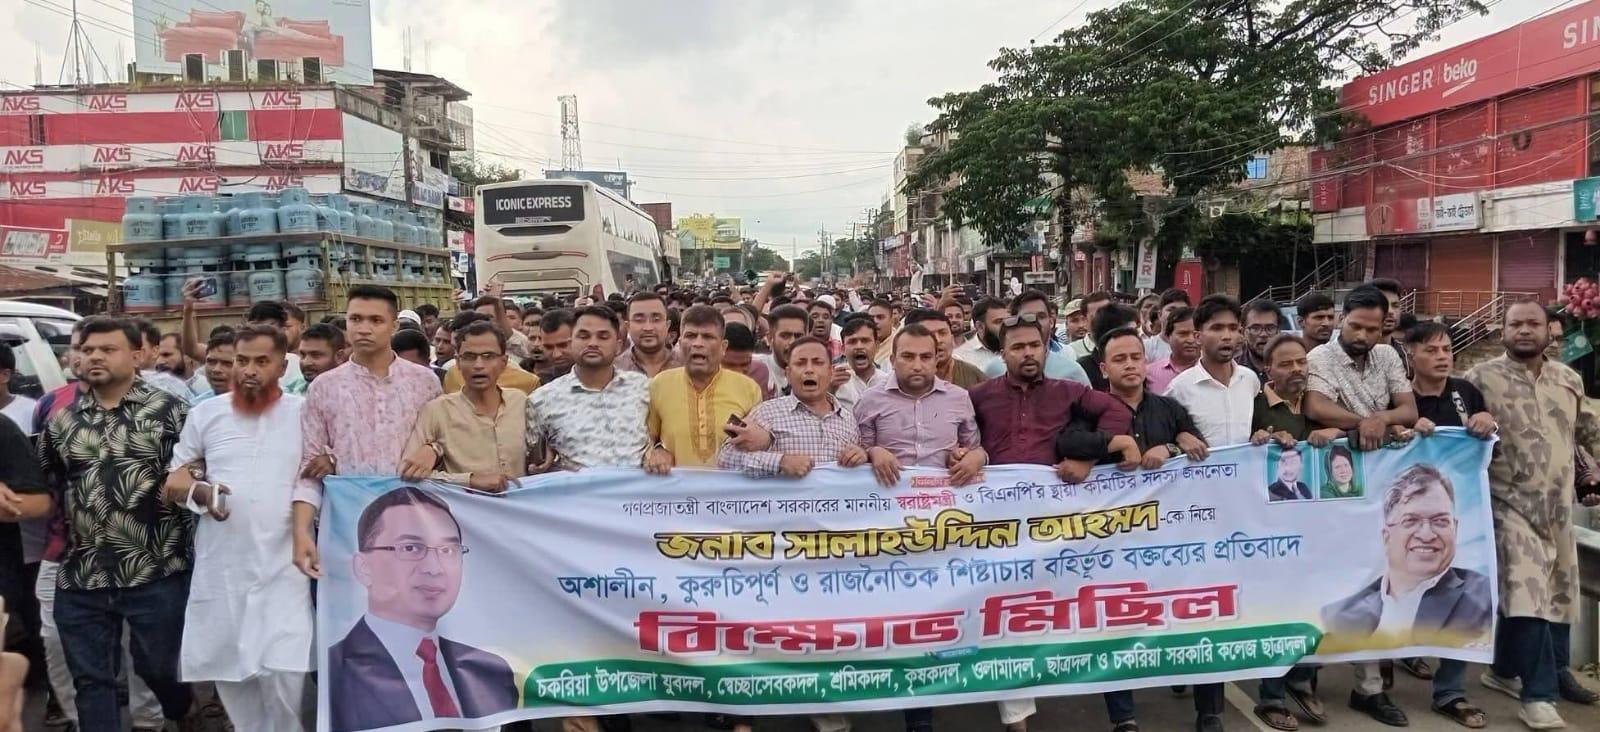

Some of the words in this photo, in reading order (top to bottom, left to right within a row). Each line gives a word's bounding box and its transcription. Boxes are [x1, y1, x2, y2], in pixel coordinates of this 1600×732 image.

[1368, 67, 1433, 106] SINGER
[1443, 58, 1477, 84] beko
[2, 96, 40, 112] AKS
[89, 94, 128, 110] AKS
[175, 93, 214, 108] AKS
[262, 91, 302, 106] AKS
[5, 150, 43, 165] AKS
[93, 147, 131, 162] AKS
[176, 146, 216, 161] AKS
[264, 144, 304, 159] AKS
[10, 181, 46, 196] AKS
[97, 178, 135, 194] AKS
[179, 177, 219, 193] AKS
[496, 197, 525, 211] ICONIC
[526, 195, 572, 210] EXPRESS
[622, 495, 700, 517] গণপ্রজাতন্ত্রী
[706, 499, 771, 516] বাংলাদেশ
[777, 498, 839, 515] সরকারের
[844, 492, 891, 512] মাননীয়
[965, 493, 974, 503] ও
[1084, 471, 1137, 494] কমিটির
[1182, 462, 1238, 480] জননেতা
[654, 531, 776, 560] জনাব
[783, 508, 1021, 560] সালাহউদ্দিন
[1189, 505, 1217, 523] নিয়ে
[676, 565, 782, 607] কুরুচিপূর্ণ
[790, 573, 809, 593] ও
[817, 560, 940, 594] রাজনৈতিক
[947, 556, 1035, 587] শিষ্টাচার
[1045, 545, 1115, 580] বহির্ভূত
[1122, 541, 1207, 571] বক্তব্যের
[1214, 532, 1304, 561] প্রতিবাদে
[633, 609, 967, 657] বিক্ষোভ
[979, 581, 1239, 639] মিছিল
[536, 669, 591, 698] চকরিয়া
[594, 665, 657, 693] উপজেলা
[1045, 652, 1094, 676] ছাত্রদল
[1097, 655, 1108, 670] ও
[1113, 642, 1161, 670] চকরিয়া
[1165, 637, 1213, 665] সরকারি
[1217, 639, 1257, 661] কলেজ
